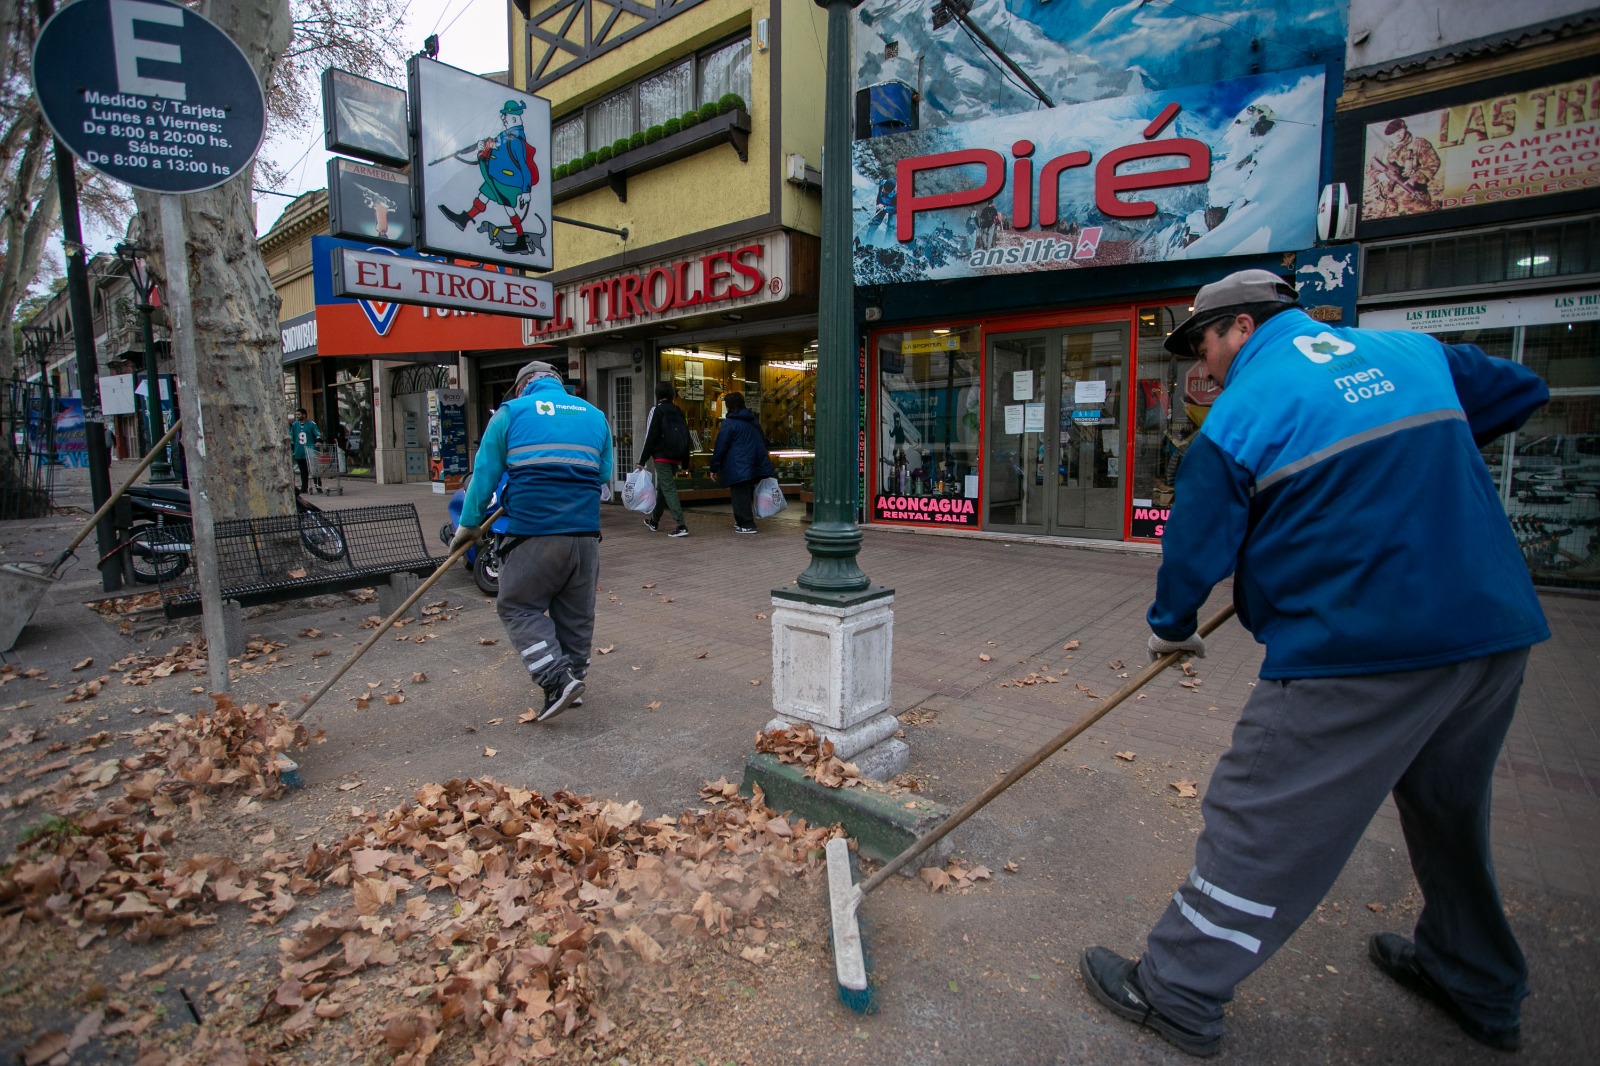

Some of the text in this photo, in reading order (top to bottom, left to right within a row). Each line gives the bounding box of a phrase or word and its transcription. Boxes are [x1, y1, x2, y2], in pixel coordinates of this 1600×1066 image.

[110, 0, 187, 101] E
[84, 90, 226, 120] Medido c/ Tarjeta
[92, 107, 222, 133] Lunes a Viernes:
[1438, 97, 1517, 149] LAS
[84, 121, 232, 148] De 8:00 a 20:00 hs.
[1478, 126, 1600, 155] CAMPIN
[129, 140, 193, 158] Sábado:
[87, 150, 231, 176] De 8:00 a 13:00 hs
[353, 165, 396, 181] ARMERIA
[896, 102, 1211, 242] Piré
[1442, 196, 1476, 208] DE
[969, 237, 1072, 269] ansilta
[355, 261, 538, 308] EL TIROLES
[580, 244, 765, 325] TIROLES
[1406, 304, 1487, 321] LAS TRINCHERAS
[1555, 294, 1600, 308] LAS TRI
[1334, 367, 1384, 390] men
[1344, 379, 1395, 403] doza
[877, 496, 974, 513] ACONCAGUA
[883, 510, 968, 522] RENTAL SALE
